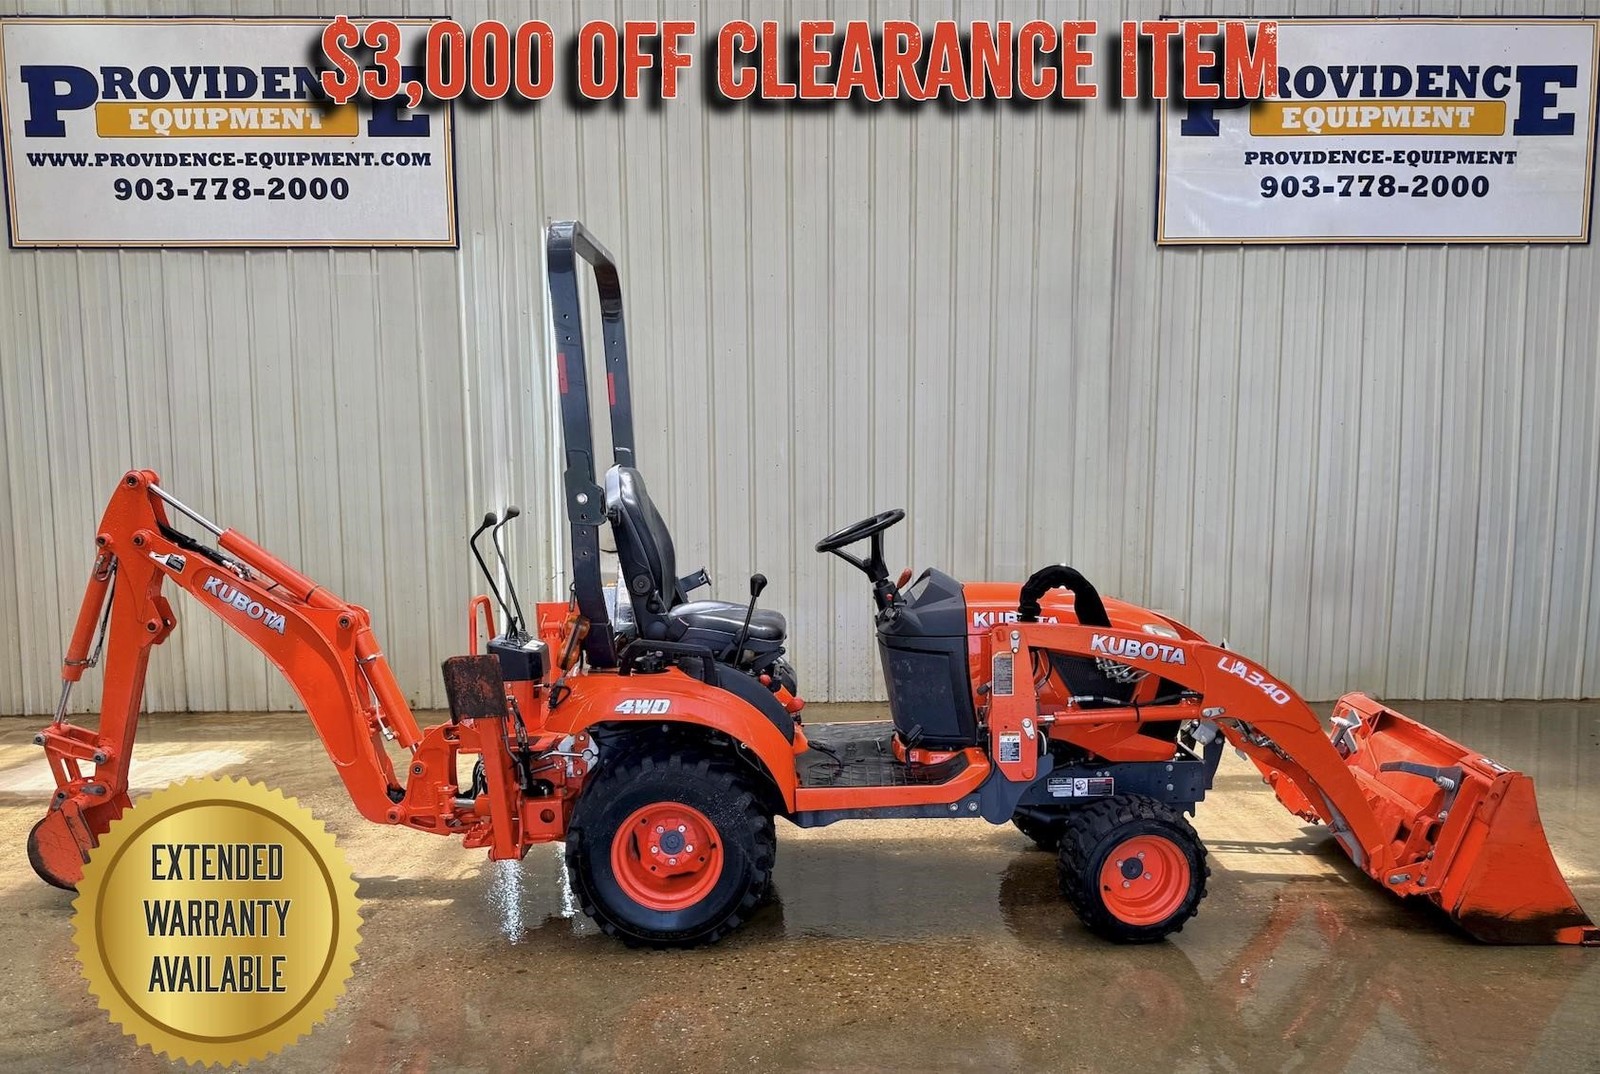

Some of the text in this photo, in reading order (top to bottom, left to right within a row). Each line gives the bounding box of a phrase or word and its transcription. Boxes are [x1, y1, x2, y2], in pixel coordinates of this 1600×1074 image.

[20, 65, 430, 137] PROVIDENE
[128, 107, 326, 136] EQUIPMENT
[1281, 106, 1475, 134] EQUIPMENT
[27, 152, 432, 170] WWW.PROVIDENCE-EQUIPMENT.COM
[1244, 150, 1517, 168] PROVIDENCE-EQUIPMENT
[113, 178, 350, 201] 903-778-2000
[1260, 175, 1490, 198] 903-778-2000
[202, 575, 288, 635] KUBOTA
[972, 611, 1059, 628] KUBTA
[1090, 633, 1187, 666] KUBOTA
[1217, 655, 1292, 706] LA340
[614, 698, 672, 715] 4WD
